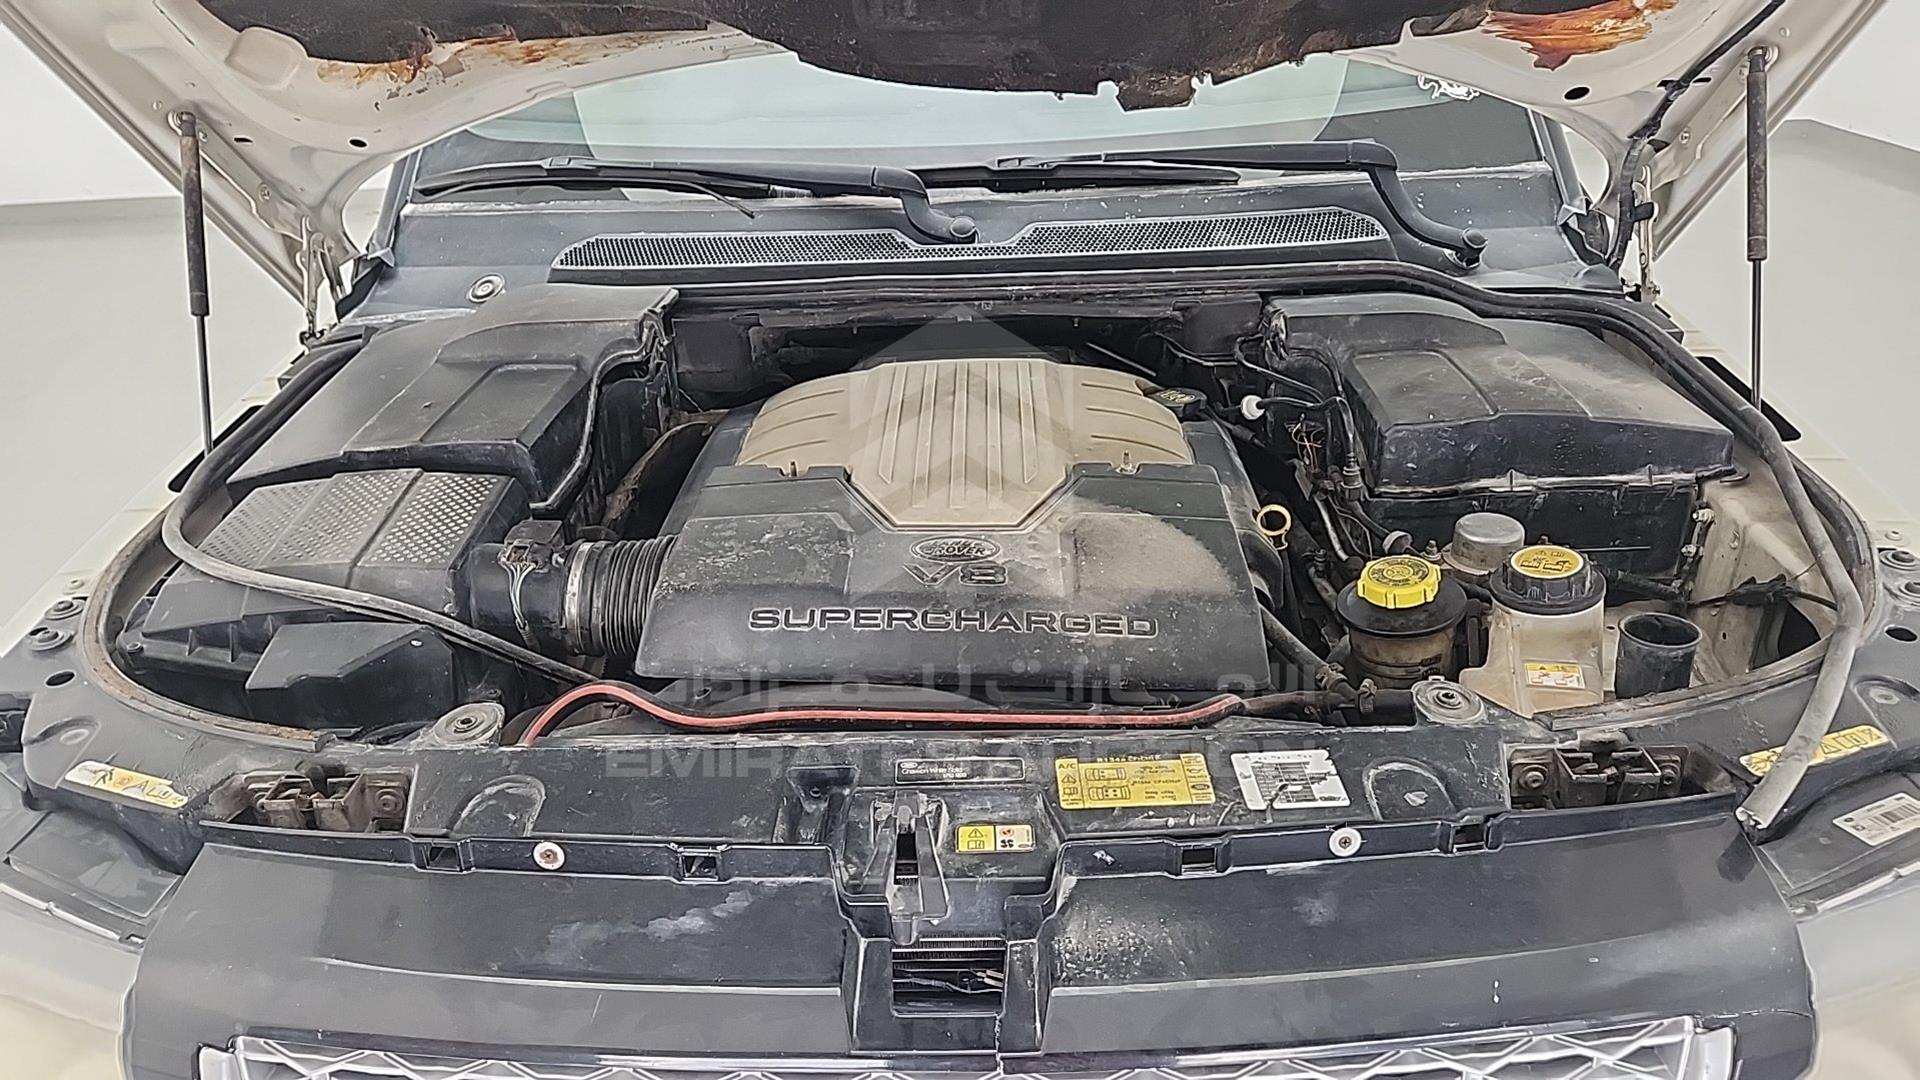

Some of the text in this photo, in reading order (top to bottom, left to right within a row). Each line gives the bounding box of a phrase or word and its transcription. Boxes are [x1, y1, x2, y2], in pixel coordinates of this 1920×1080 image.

[934, 546, 986, 556] ROVER
[903, 562, 1008, 587] V8
[748, 607, 1160, 638] SUPERCHARGED
[1058, 762, 1076, 770] A/C
